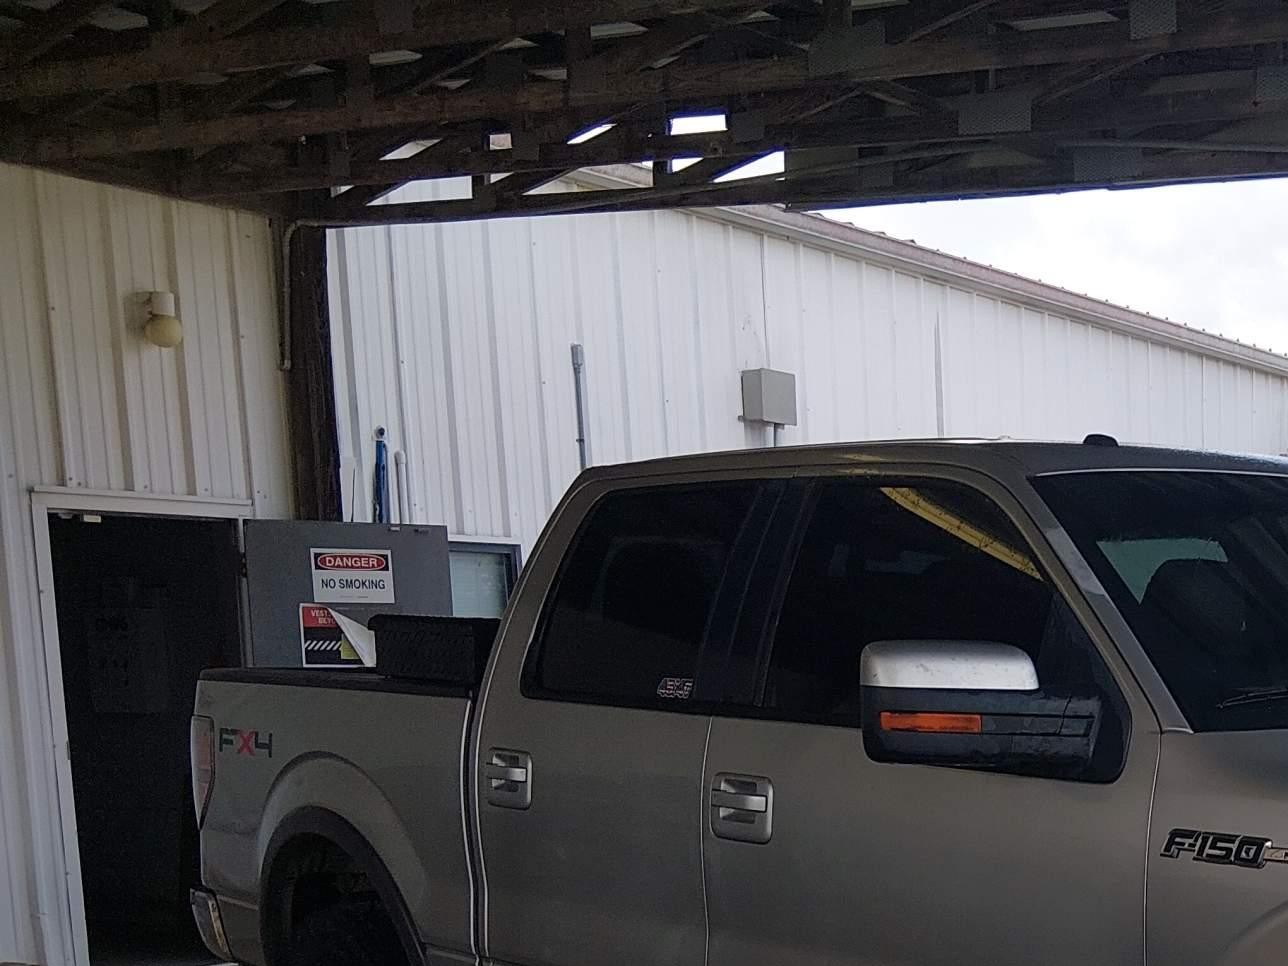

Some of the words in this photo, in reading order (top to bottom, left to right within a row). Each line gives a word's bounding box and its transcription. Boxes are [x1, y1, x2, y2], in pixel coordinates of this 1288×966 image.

[325, 556, 378, 568] DANGER
[321, 578, 336, 589] NO
[338, 579, 386, 590] SMOKING
[311, 609, 332, 617] VEST
[219, 727, 273, 758] FX4
